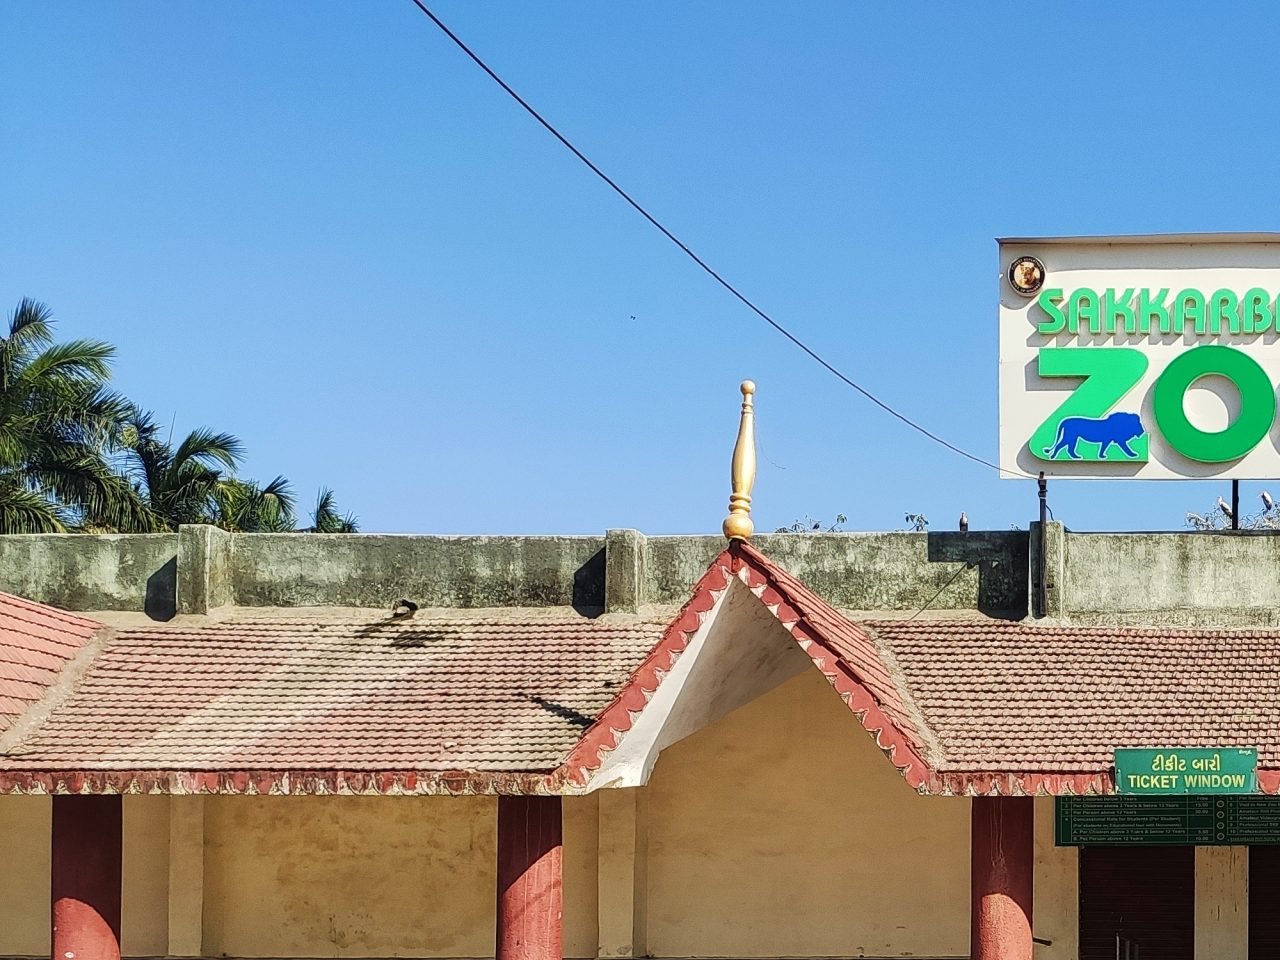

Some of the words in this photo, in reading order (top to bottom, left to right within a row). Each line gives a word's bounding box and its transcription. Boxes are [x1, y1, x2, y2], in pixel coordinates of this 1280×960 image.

[1151, 753, 1187, 772] ટીકીટ
[1191, 753, 1221, 771] બારી
[1127, 775, 1179, 789] TICKET
[1184, 774, 1246, 788] WINDOW
